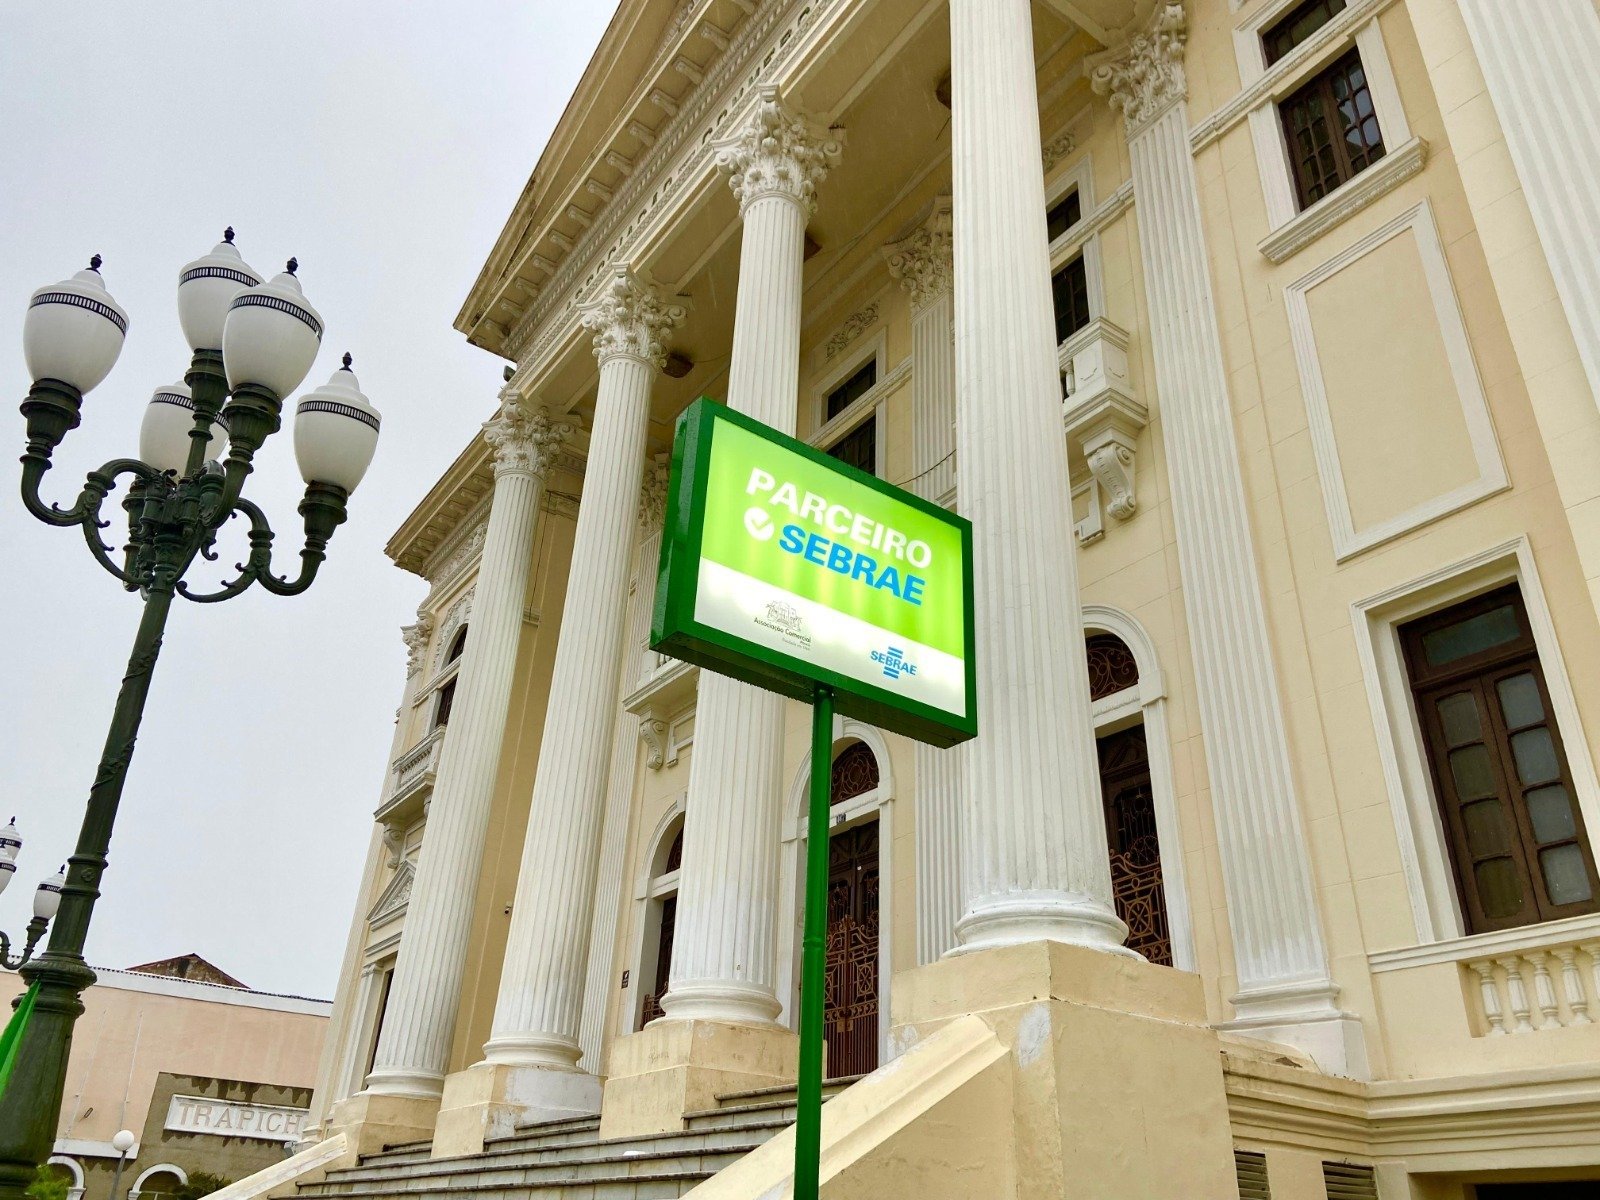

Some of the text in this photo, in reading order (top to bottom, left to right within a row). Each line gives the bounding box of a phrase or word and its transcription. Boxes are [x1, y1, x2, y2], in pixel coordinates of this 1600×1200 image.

[745, 467, 932, 569] PARCEIRO
[779, 524, 926, 606] SEBRAE
[785, 628, 811, 644] Comercial
[870, 650, 917, 676] SEBRAE
[180, 1102, 302, 1135] TRAPICH
